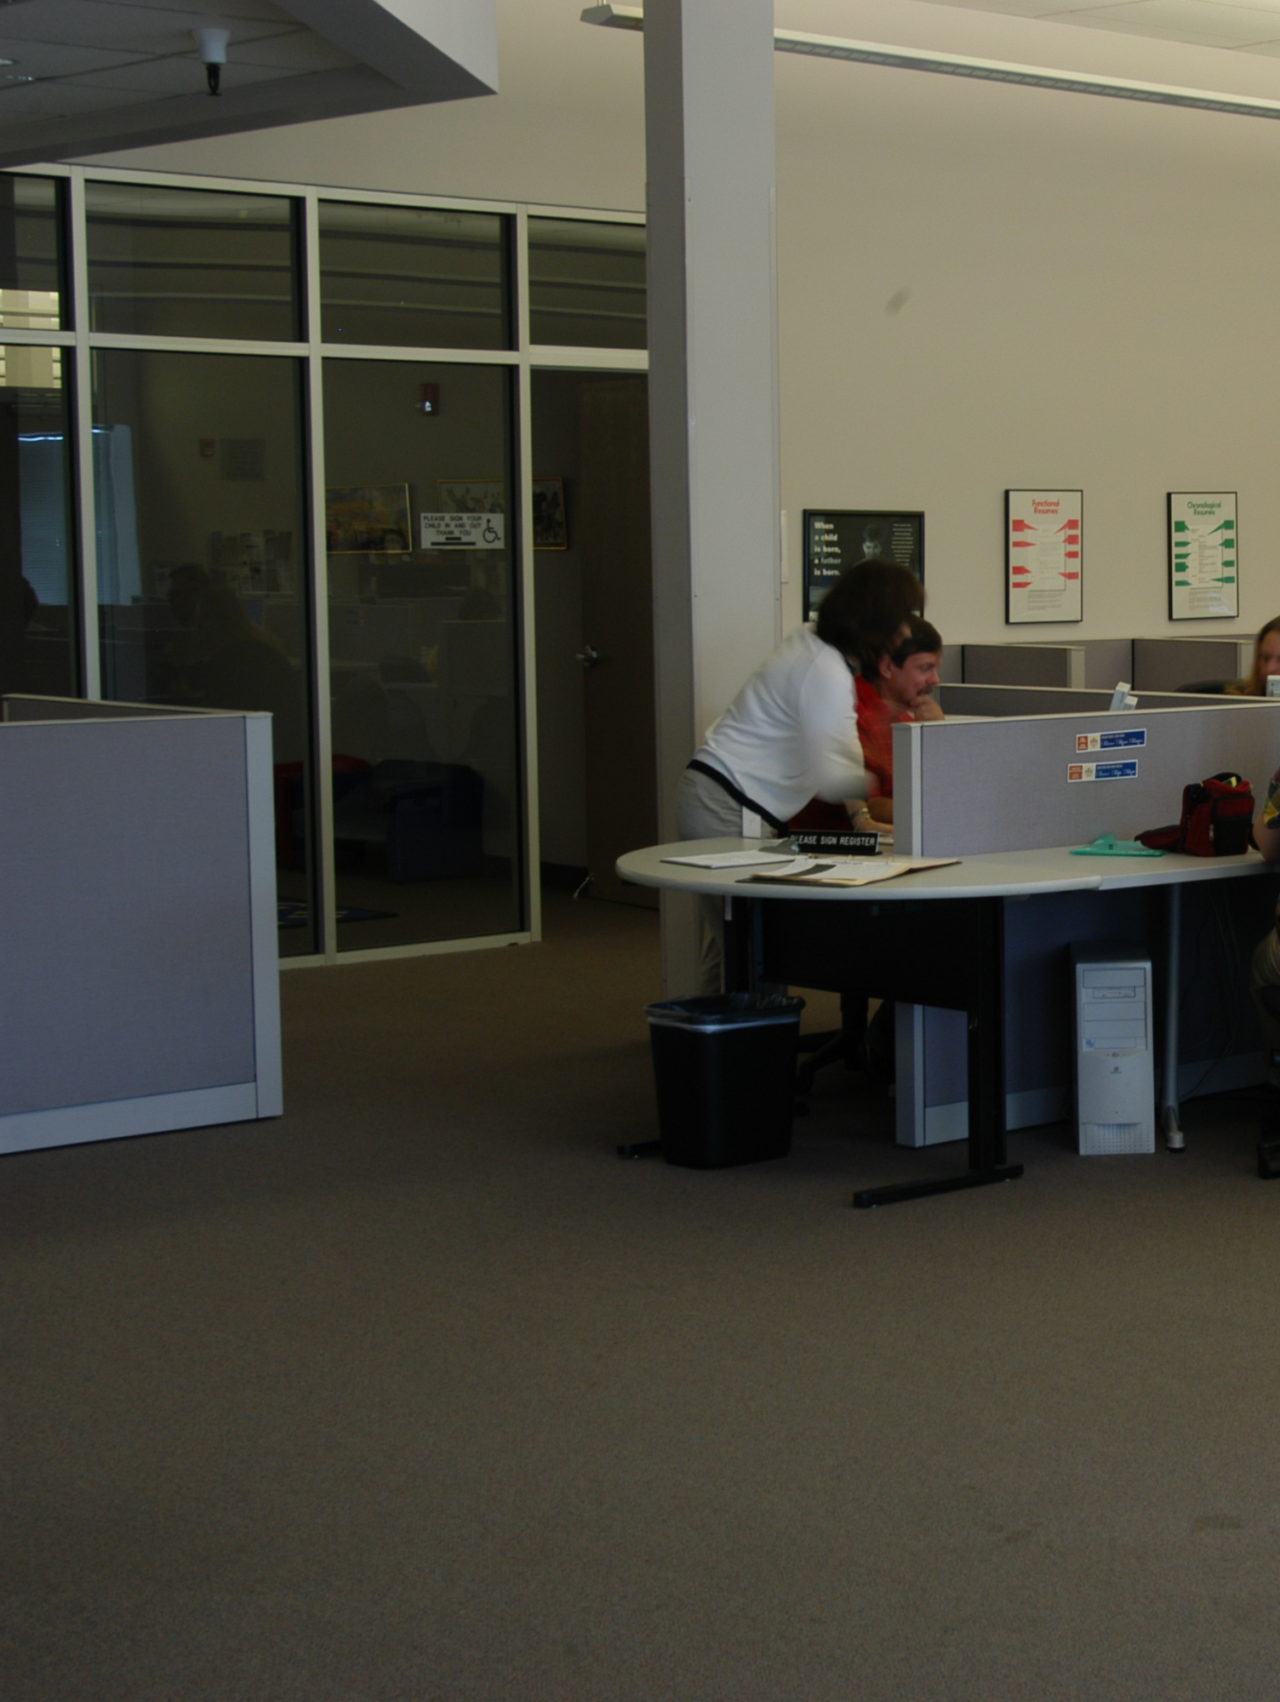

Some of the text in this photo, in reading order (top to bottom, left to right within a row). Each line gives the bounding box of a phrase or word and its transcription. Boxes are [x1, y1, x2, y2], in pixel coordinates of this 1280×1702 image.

[814, 522, 834, 530] When
[814, 545, 841, 554] is born,
[814, 568, 840, 576] is born.
[820, 836, 837, 845] SIGN
[839, 837, 875, 846] REGISTER
